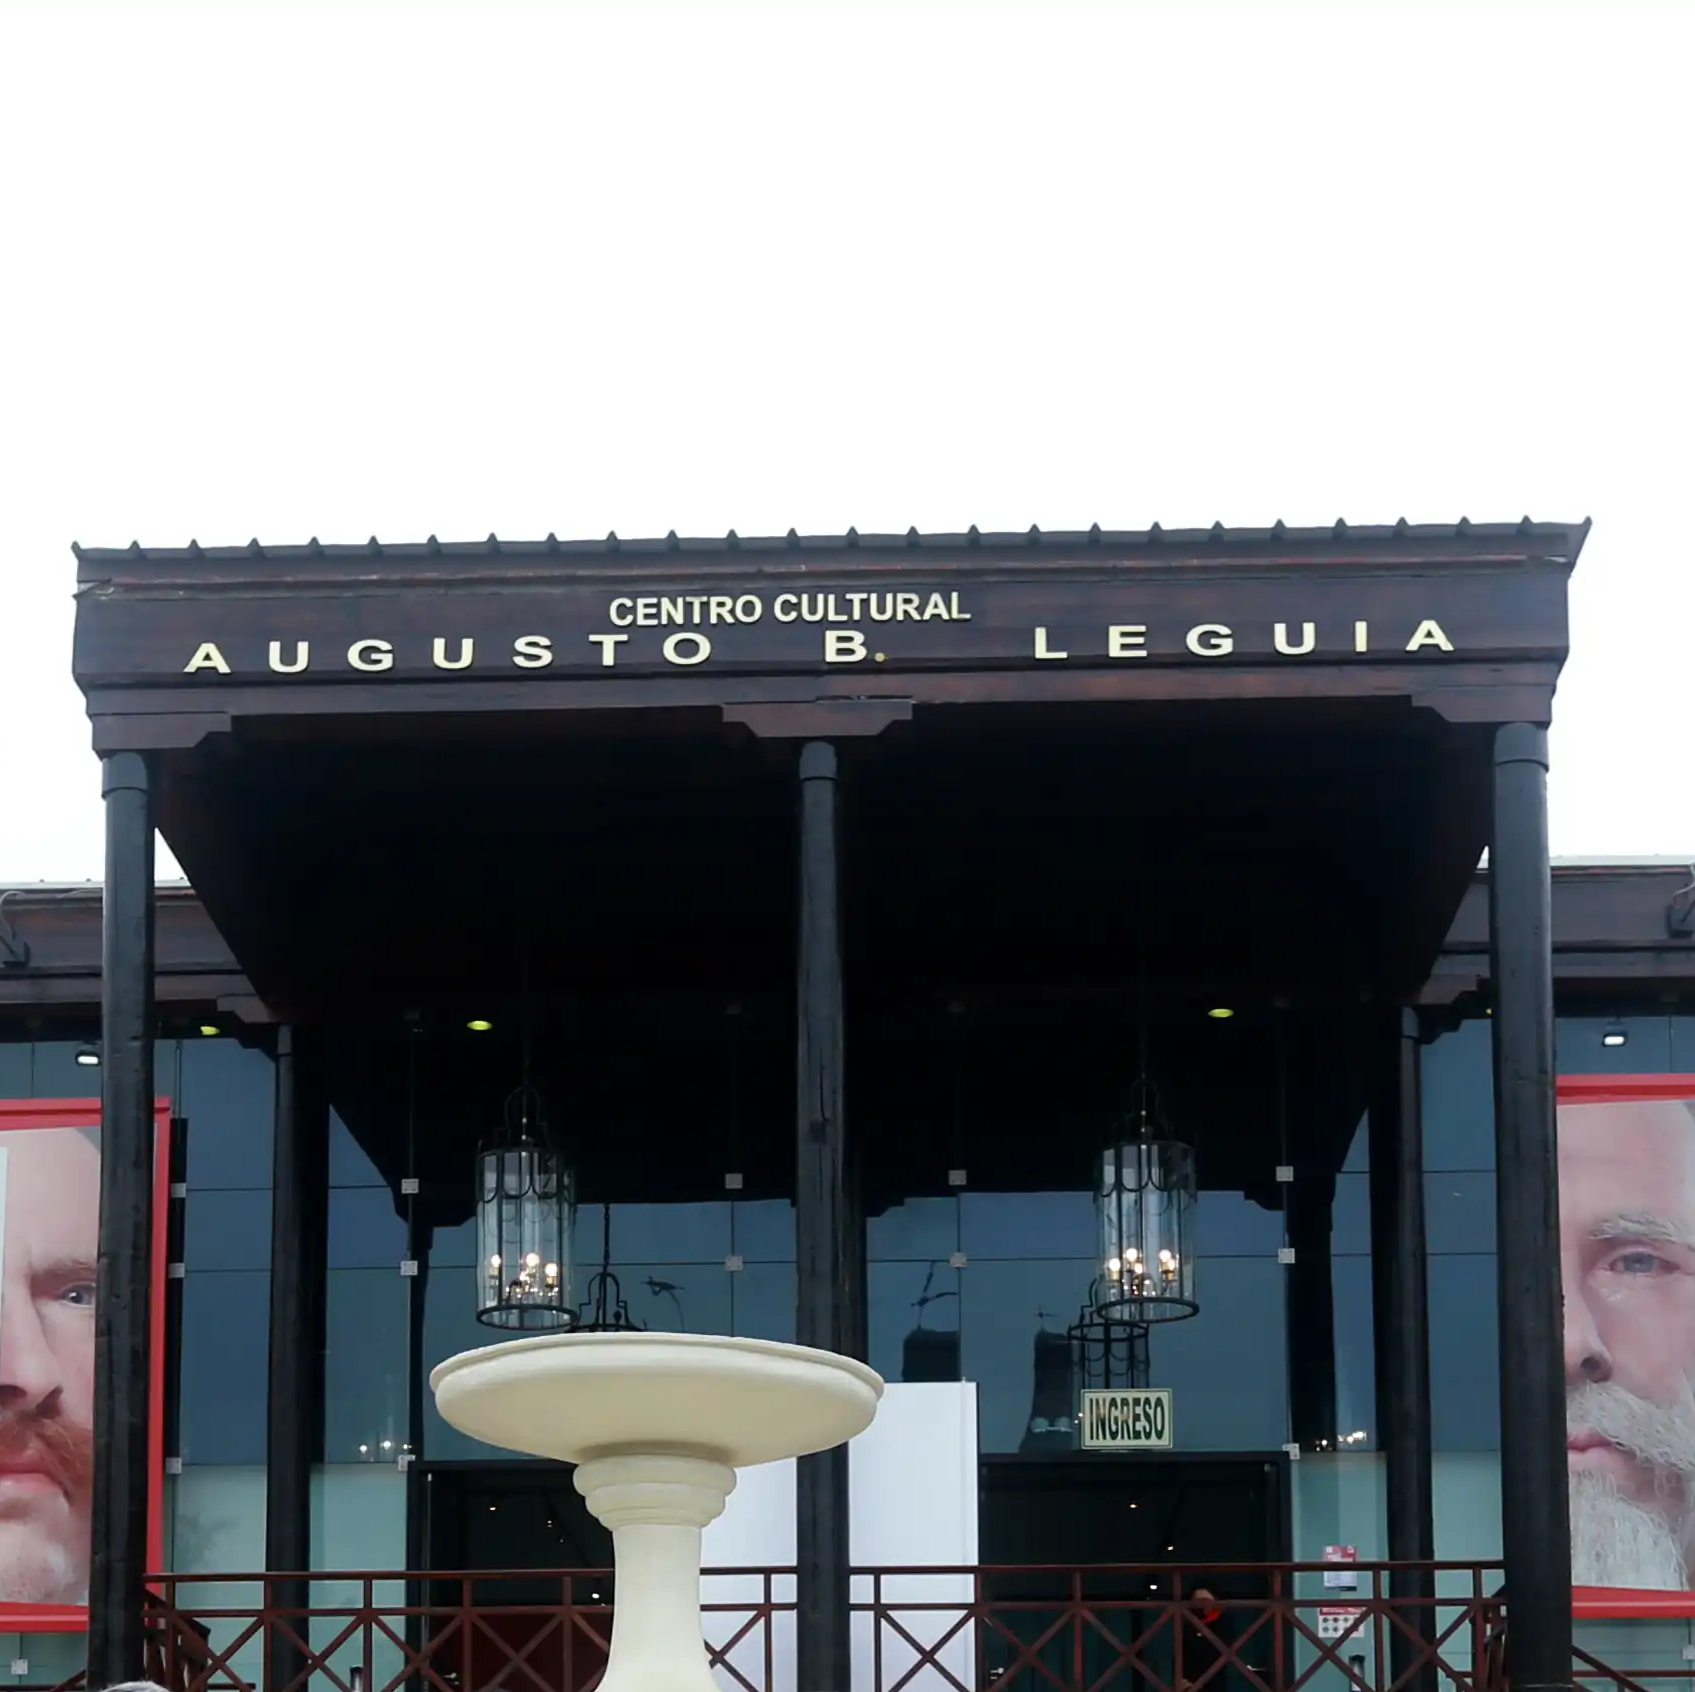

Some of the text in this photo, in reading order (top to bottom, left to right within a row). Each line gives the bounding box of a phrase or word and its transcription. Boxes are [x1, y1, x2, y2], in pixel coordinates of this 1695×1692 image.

[609, 591, 971, 627] CENTRO CULTURAL
[183, 619, 1455, 674] AUGUSTO B. LEGUIA
[1089, 1397, 1165, 1440] INGRESO
